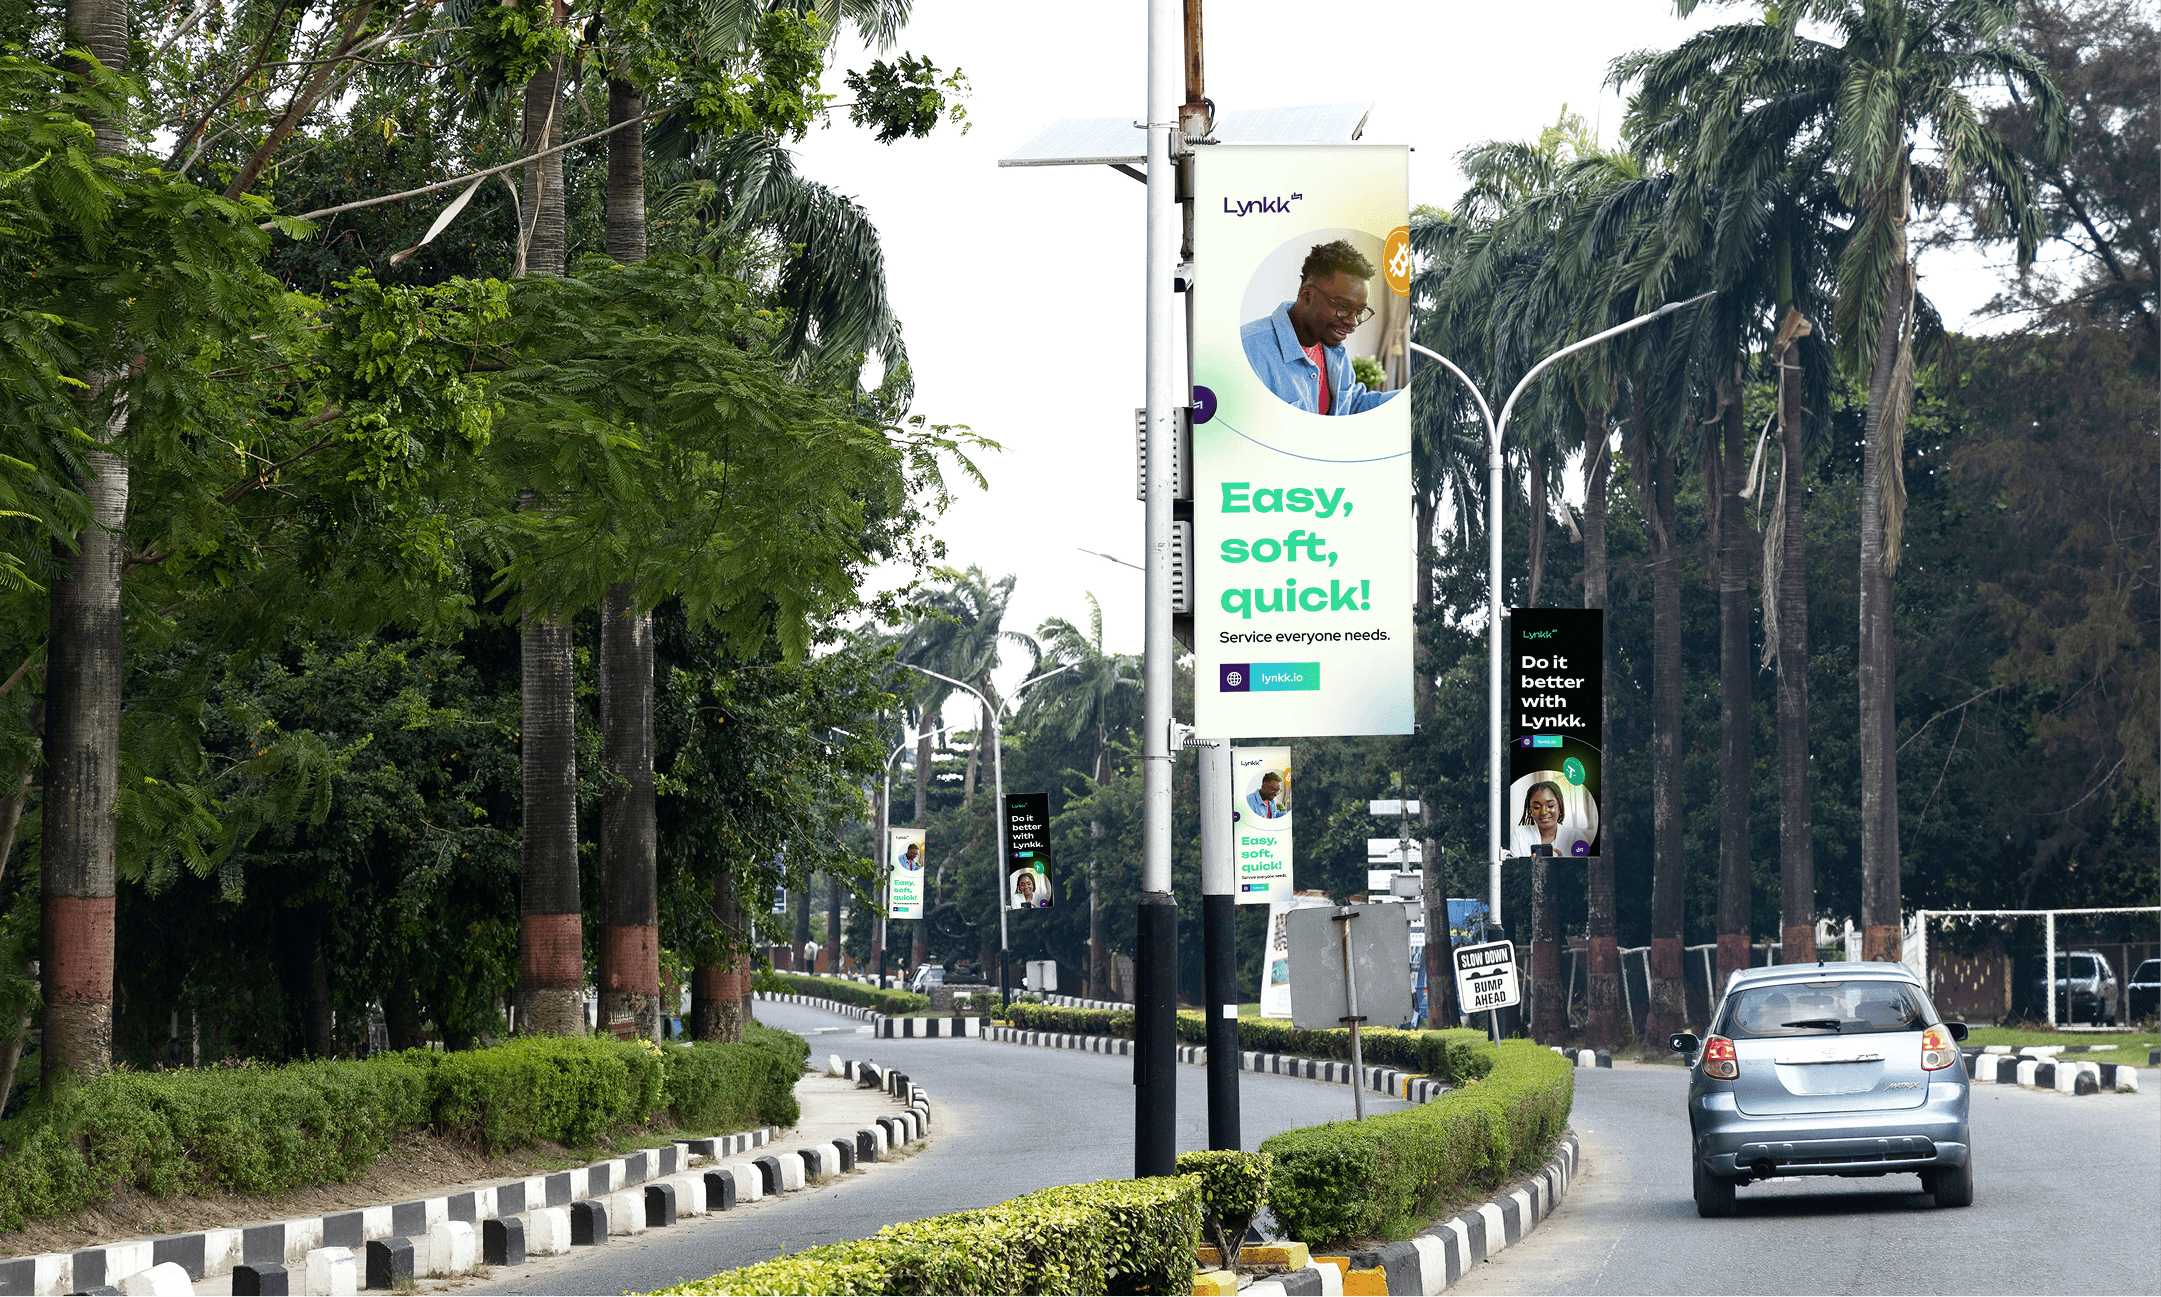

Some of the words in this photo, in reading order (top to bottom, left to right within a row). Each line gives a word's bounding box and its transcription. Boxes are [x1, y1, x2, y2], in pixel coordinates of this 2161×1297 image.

[1224, 196, 1290, 217] Lynkk
[1221, 482, 1353, 518] Easy,
[1220, 529, 1338, 567] soft,
[1220, 578, 1371, 619] quick!
[1219, 631, 1272, 643] Service
[1275, 632, 1342, 645] everyone
[1344, 629, 1391, 642] needs.
[1523, 630, 1552, 640] Lynkk
[1522, 656, 1549, 669] Do
[1553, 654, 1568, 669] it
[1261, 673, 1304, 685] lynkk.io
[1522, 675, 1585, 688] better
[1521, 693, 1567, 708] with
[1522, 714, 1586, 729] Lynkk.
[1013, 832, 1034, 840] with
[1241, 836, 1277, 846] Easy,
[1013, 841, 1043, 849] Lynkk.
[1241, 848, 1273, 859] soft,
[1241, 861, 1282, 873] quick!
[1461, 952, 1483, 968] SLOW
[1484, 948, 1508, 964] DOWN
[1474, 979, 1503, 993] BUMP
[1475, 991, 1506, 1006] AHEAD
